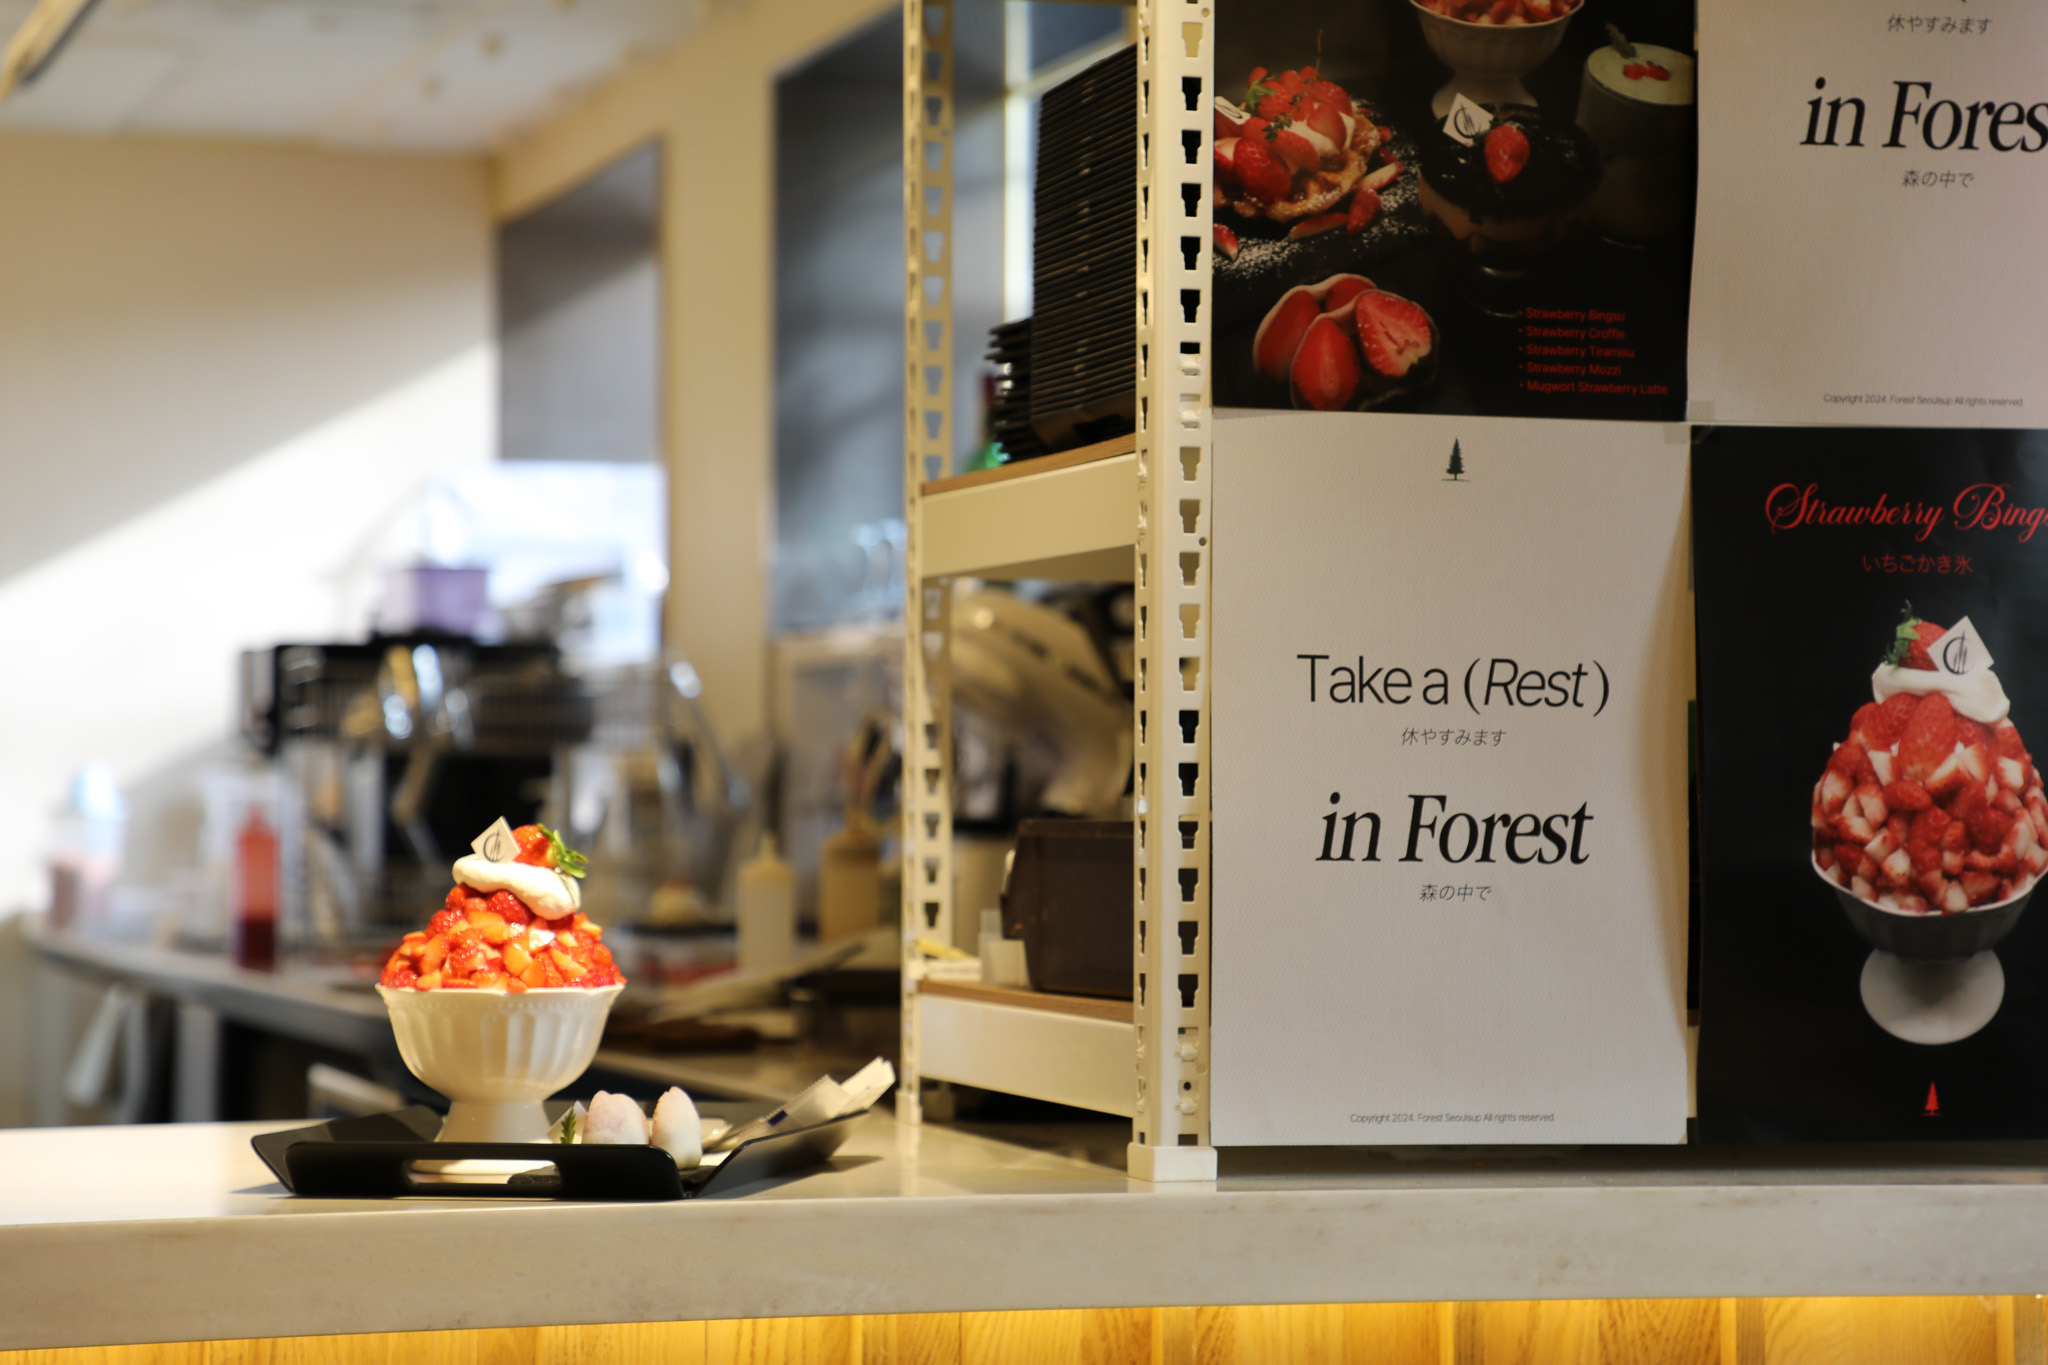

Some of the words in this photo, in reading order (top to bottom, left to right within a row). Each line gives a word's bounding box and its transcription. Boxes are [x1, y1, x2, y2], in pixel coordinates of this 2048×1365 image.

[1887, 14, 1992, 35] 休やすみます
[1800, 77, 1865, 147] in
[1903, 170, 1974, 188] 森の中で
[1526, 307, 1586, 322] Strawberry
[1588, 309, 1625, 323] Bingsu
[1526, 325, 1586, 340] Strawberry
[1527, 344, 1586, 358] Strawberry
[1589, 345, 1635, 358] Tiramisu
[1527, 362, 1587, 376] Strawberry
[1589, 364, 1621, 375] Mozzi
[1527, 380, 1576, 394] Mugwort
[1578, 381, 1638, 396] Strawberry
[1640, 384, 1668, 395] Latte
[1824, 393, 1863, 405] Copyright
[1890, 395, 1915, 404] Forest
[1954, 396, 1965, 405] All
[1965, 397, 1987, 408] rights
[1765, 483, 1944, 542] Strawberry
[1863, 554, 1972, 574] いちごかき氷
[1297, 654, 1412, 704] Take
[1423, 668, 1448, 705] a
[1402, 728, 1506, 746] 休やすみます
[1315, 792, 1381, 861] in
[1399, 795, 1594, 864] Forest
[1420, 884, 1491, 902] 森の中で
[1350, 1113, 1390, 1125] Copyright
[1418, 1113, 1443, 1122] Forest
[1483, 1113, 1493, 1121] All
[1495, 1114, 1517, 1124] rights
